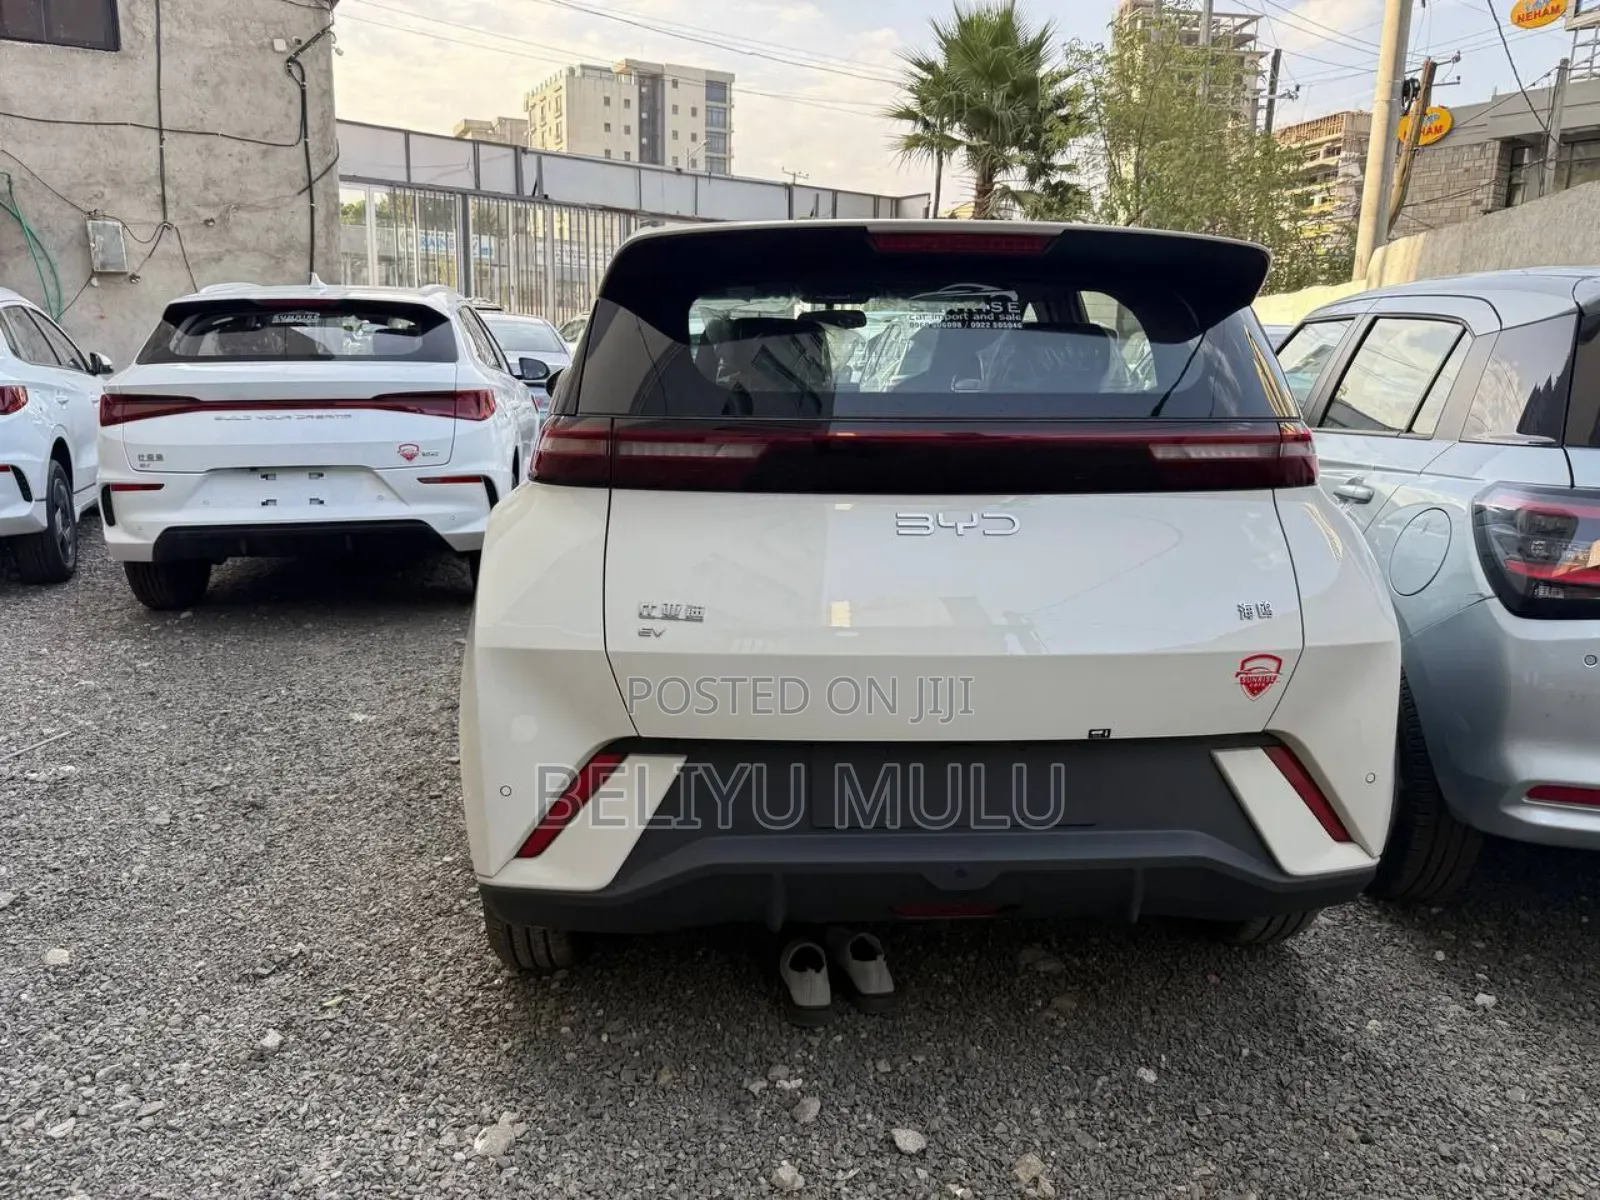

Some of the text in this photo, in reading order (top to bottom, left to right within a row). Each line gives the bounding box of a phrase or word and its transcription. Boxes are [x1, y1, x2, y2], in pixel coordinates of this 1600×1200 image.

[1517, 5, 1561, 22] NEHAM
[933, 311, 969, 322] import
[973, 311, 994, 320] and
[1000, 311, 1022, 320] sale
[895, 512, 1020, 536] BYD
[638, 628, 667, 638] EV
